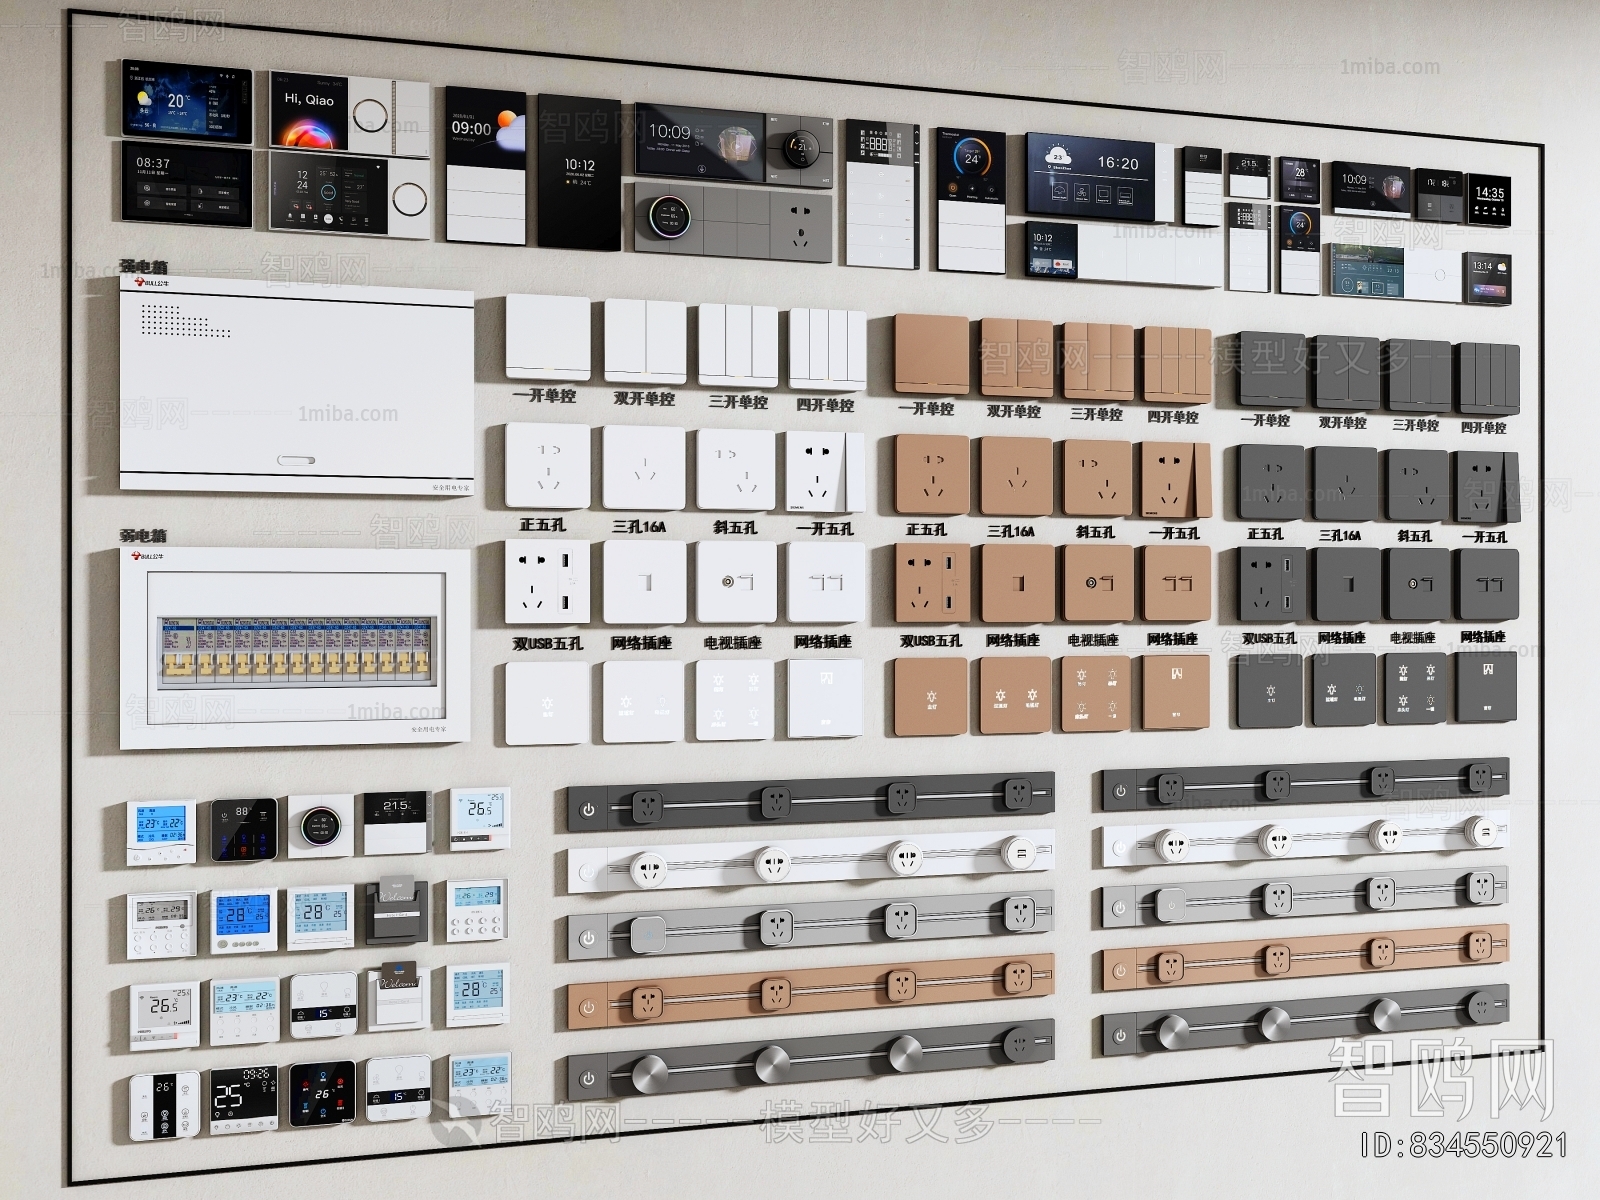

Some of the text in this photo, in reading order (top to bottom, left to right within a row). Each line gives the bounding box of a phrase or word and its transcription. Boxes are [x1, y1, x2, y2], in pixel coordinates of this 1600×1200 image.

[168, 93, 184, 108] 20
[285, 92, 335, 107] Hi, Qiao
[452, 121, 492, 136] 09:00
[649, 123, 692, 140] 10:09
[136, 156, 170, 169] 08:37
[566, 158, 596, 172] 10:12
[1098, 156, 1139, 170] 16:20
[297, 170, 308, 180] 12
[1296, 168, 1306, 177] 28
[1342, 174, 1367, 185] 10:09
[296, 180, 308, 190] 24
[1476, 186, 1504, 198] 14:35
[1033, 233, 1053, 243] 10:12
[1474, 262, 1492, 270] 13:14
[512, 387, 577, 404] 一开单控
[613, 391, 676, 407] 双开单控
[708, 394, 769, 410] 三开单控
[796, 397, 855, 413] 四开单控
[897, 401, 955, 416] 一开单控
[987, 405, 1042, 419] 双开单控
[1070, 408, 1123, 422] 三开单控
[1147, 411, 1199, 425] 四开单控
[1240, 413, 1291, 428] 一开单控
[1318, 416, 1368, 430] 双开单控
[1392, 418, 1440, 432] 三开单控
[1461, 421, 1508, 435] 四开单控
[519, 516, 568, 533] 正五孔
[611, 519, 667, 534] 三孔16A
[713, 519, 759, 535] 斜五孔
[795, 521, 855, 537] 一开五孔
[905, 522, 948, 537] 正五孔
[987, 524, 1036, 539] 三孔16A
[1075, 524, 1116, 539] 斜五孔
[1148, 526, 1201, 540] 一开五孔
[1246, 527, 1285, 541] 正五孔
[1319, 528, 1362, 542] 三孔16A
[1397, 529, 1433, 543] 斜五孔
[1461, 530, 1509, 544] 一开五孔
[512, 635, 585, 652] 双USB五孔
[610, 635, 673, 651] 网络插座
[703, 635, 763, 651] 电视插座
[793, 633, 853, 649] 网络插座
[899, 633, 963, 649] 双USB五孔
[985, 632, 1041, 648] 网络插座
[1067, 632, 1119, 648] 电视插座
[1147, 631, 1199, 647] 网络插座
[1242, 631, 1298, 646] 双USB五孔
[1317, 630, 1367, 645] 网络插座
[1390, 631, 1436, 645] 电视插座
[1460, 629, 1507, 644] 网络插座
[383, 801, 408, 811] 21.5
[146, 818, 180, 829] 23 22
[227, 908, 246, 923] 28
[304, 904, 324, 920] 28
[334, 910, 342, 918] 25
[462, 982, 480, 997] 28
[226, 992, 268, 1002] 23 22
[320, 1008, 328, 1018] 15
[244, 1068, 270, 1080] 09:26
[462, 1066, 502, 1076] 23 22
[156, 1082, 170, 1092] 26
[214, 1084, 242, 1108] 25
[316, 1090, 330, 1099] 26
[394, 1092, 403, 1101] 15
